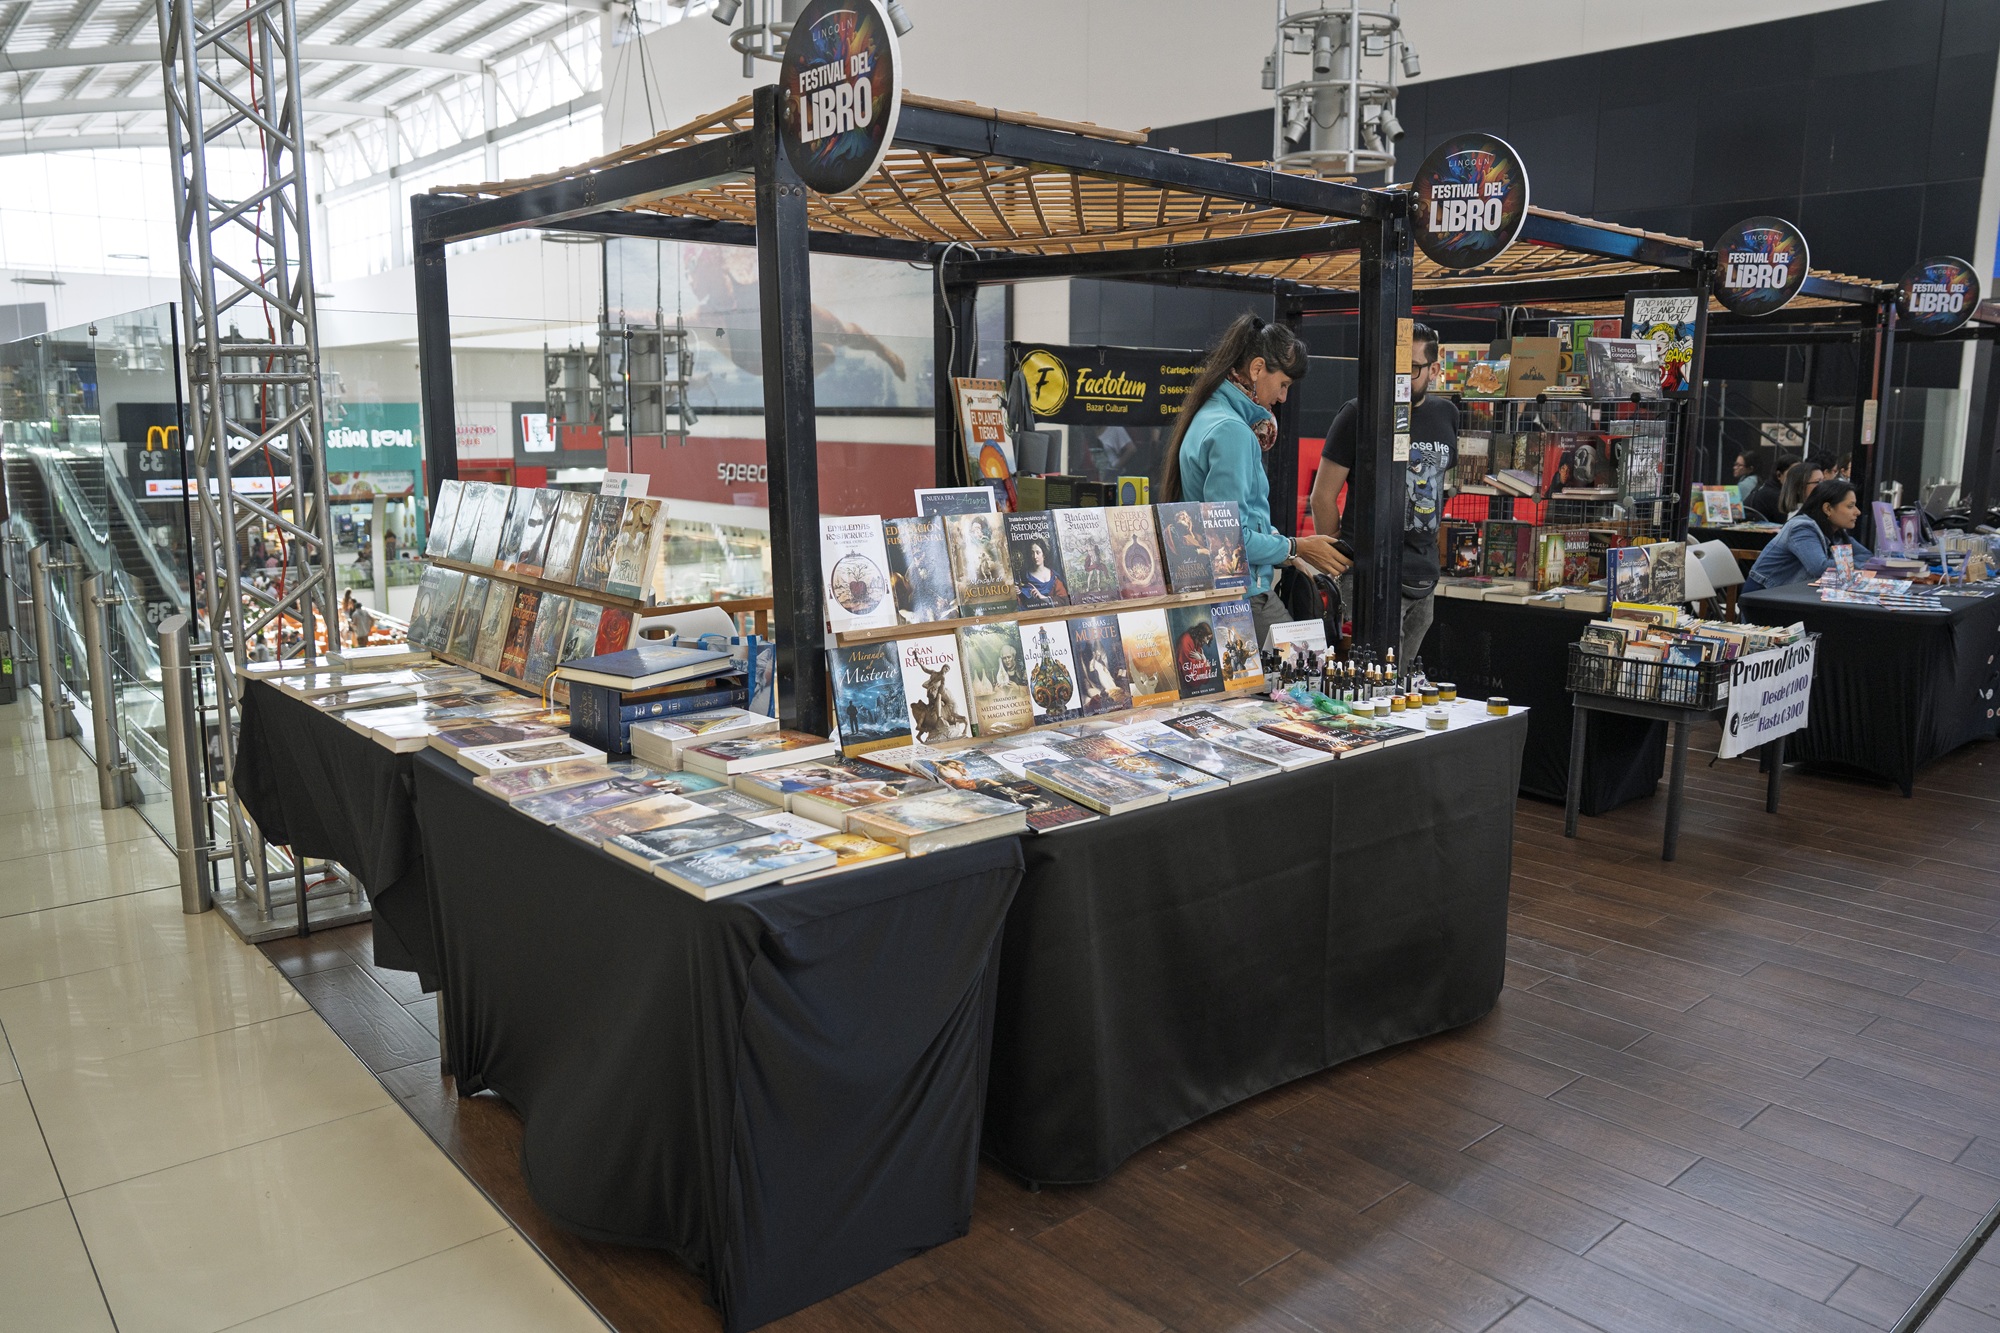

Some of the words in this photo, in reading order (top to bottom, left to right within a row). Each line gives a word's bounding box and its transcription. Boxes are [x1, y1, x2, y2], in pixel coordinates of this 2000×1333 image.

[812, 17, 854, 42] LINCOLN
[799, 58, 846, 94] FESTIVAL
[850, 50, 871, 76] DEL
[799, 76, 873, 143] LIBRO
[1448, 156, 1491, 168] LINCOLN
[1431, 183, 1480, 199] FESTIVAL
[1483, 181, 1503, 197] DEL
[1428, 197, 1503, 233] LIBRO
[1743, 233, 1779, 241] LINCOLN
[1728, 252, 1769, 263] FESTIVAL
[1773, 252, 1789, 263] DEL
[1725, 264, 1788, 289] LIBRO
[1912, 283, 1947, 293] FESTIVAL
[1950, 283, 1965, 293] DEL
[1636, 299, 1656, 307] FIND
[1657, 298, 1677, 307] WHAT
[1679, 298, 1696, 306] YOU
[1909, 293, 1964, 313] LIBRO
[1636, 307, 1658, 315] LOVE
[1658, 306, 1674, 314] AND
[1676, 305, 1692, 314] LET
[1638, 314, 1647, 322] IT
[1649, 314, 1666, 322] KILL
[1664, 348, 1693, 363] BANG
[1036, 366, 1055, 401] F
[1076, 367, 1147, 398] Factotum
[1086, 402, 1104, 412] Bazar
[1105, 403, 1128, 413] Cultural
[971, 411, 978, 424] EL
[978, 412, 1003, 425] PLANETA
[327, 427, 369, 448] SEÑOR
[371, 428, 414, 448] BOWL
[978, 426, 999, 440] TIERRA
[1434, 441, 1450, 454] life
[1113, 510, 1147, 520] MISTERIOS
[1207, 508, 1232, 519] MAGIA
[1010, 521, 1049, 532] Astrología
[1114, 519, 1149, 532] FUEGO
[1203, 516, 1240, 529] PRÁCTICA
[1011, 530, 1051, 541] Hermética
[1565, 541, 1589, 551] LMANAC
[963, 584, 1011, 598] ACUARIO
[1211, 603, 1250, 617] OCULTISMO
[1075, 625, 1117, 643] MUERTE
[848, 643, 886, 663] Mirando
[906, 645, 933, 656] GRAN
[865, 661, 872, 670] el
[905, 652, 955, 668] REBELIÓN
[840, 666, 899, 686] Misterio
[980, 704, 1010, 713] MEDICINA
[1010, 700, 1031, 709] OCULTA
[987, 711, 1006, 720] MAGIA
[1006, 707, 1033, 717] PRÁCTICA
